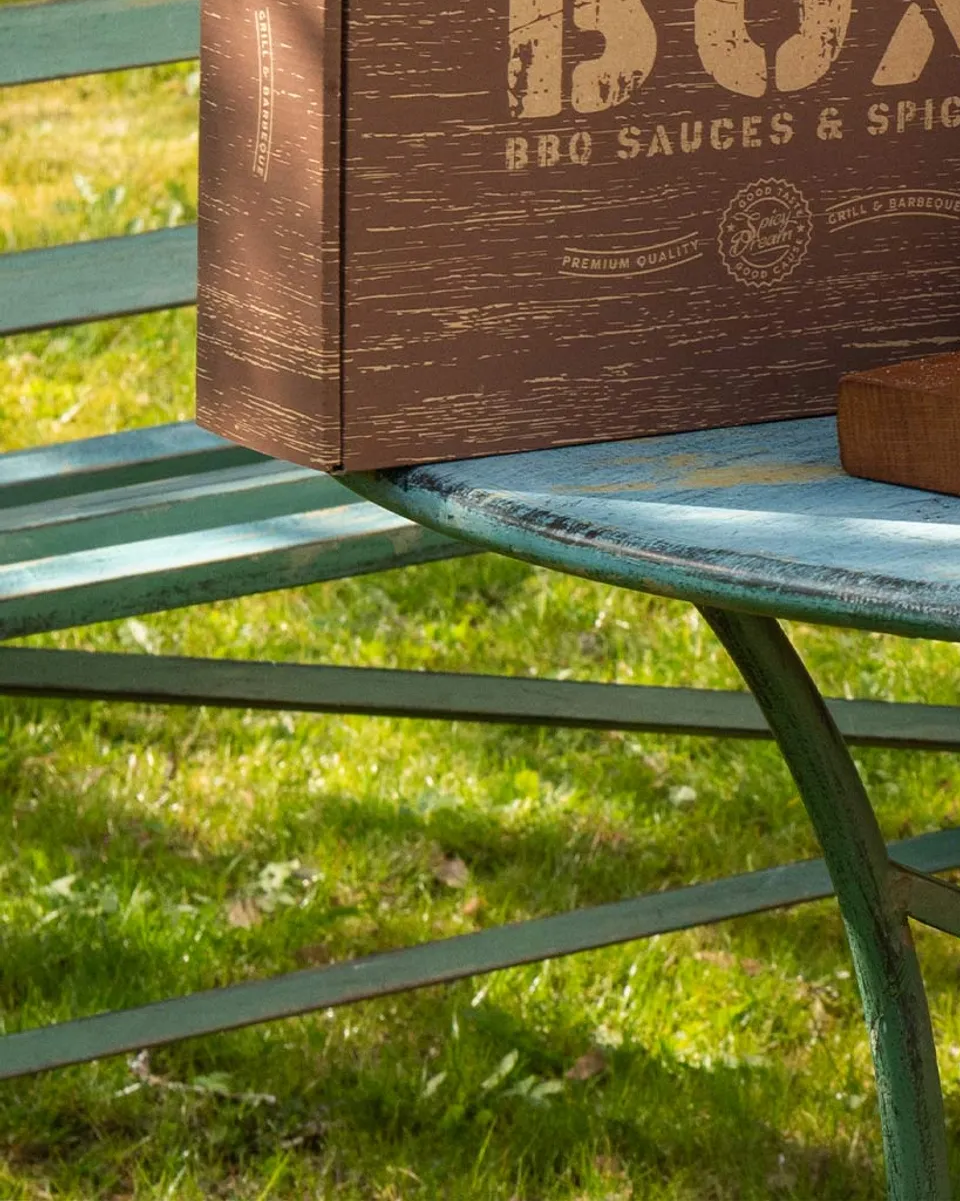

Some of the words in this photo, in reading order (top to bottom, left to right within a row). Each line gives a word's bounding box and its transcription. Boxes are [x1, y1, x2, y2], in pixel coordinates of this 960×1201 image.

[258, 9, 269, 59] GRILL
[256, 86, 270, 178] BARBEQUE
[505, 130, 593, 170] BBQ
[616, 111, 795, 160] SAUCES
[816, 106, 844, 140] &
[738, 186, 772, 208] GOOD
[828, 204, 868, 225] GRILL
[873, 200, 883, 212] &
[561, 254, 631, 271] PREMIUM
[636, 239, 700, 269] QUALITY
[736, 261, 769, 280] GOOD
